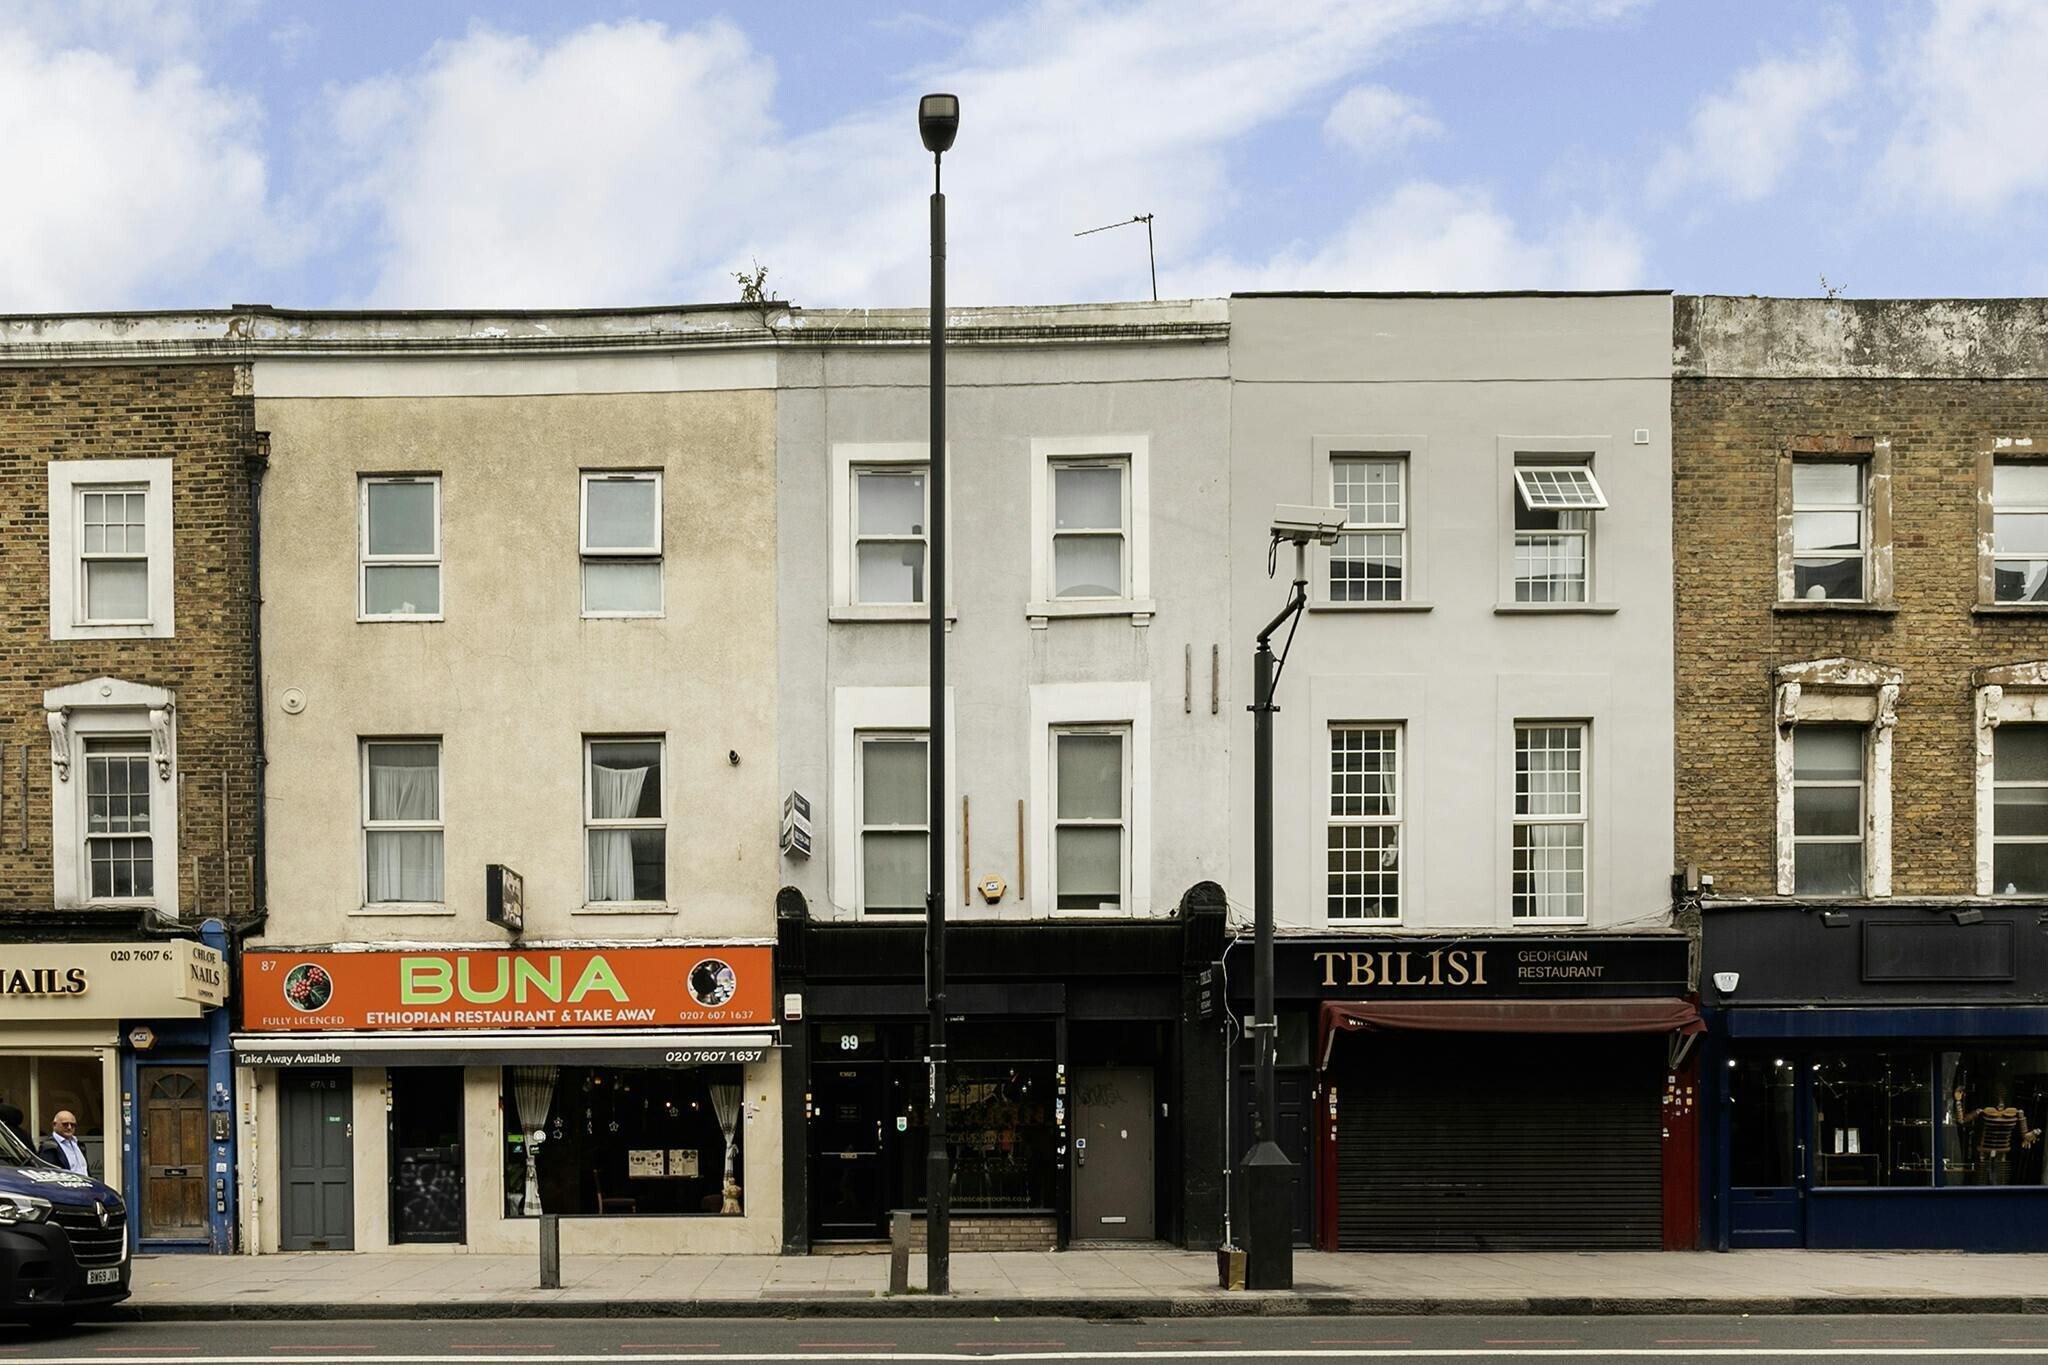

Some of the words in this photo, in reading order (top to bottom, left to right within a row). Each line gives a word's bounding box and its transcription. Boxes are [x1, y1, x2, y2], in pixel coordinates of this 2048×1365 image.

[110, 950, 131, 961] 020
[133, 950, 160, 961] 7607
[193, 947, 216, 964] CHLOE
[1517, 950, 1588, 962] GEORGIAN
[261, 961, 277, 971] 87
[1313, 951, 1488, 986] TBILISI
[1517, 966, 1604, 978] RESTAURANT
[190, 963, 220, 986] NAILS
[400, 955, 630, 1005] BUNA
[262, 1016, 291, 1025] FULLY
[294, 1015, 345, 1025] LICENCED
[366, 1011, 451, 1025] ETHIOPIAN
[454, 1009, 556, 1024] RESTAURANT
[561, 1009, 571, 1022] &
[573, 1009, 612, 1022] TAKE
[615, 1008, 656, 1022] AWAY
[680, 1011, 705, 1021] 0207
[707, 1011, 726, 1020] 607
[730, 1010, 754, 1020] 1637
[841, 1035, 859, 1050] 89
[239, 1054, 263, 1065] Take
[264, 1054, 293, 1066] Away
[294, 1053, 341, 1064] Available
[665, 1051, 692, 1062] 020
[693, 1051, 727, 1062] 7607
[729, 1050, 762, 1061] 1637
